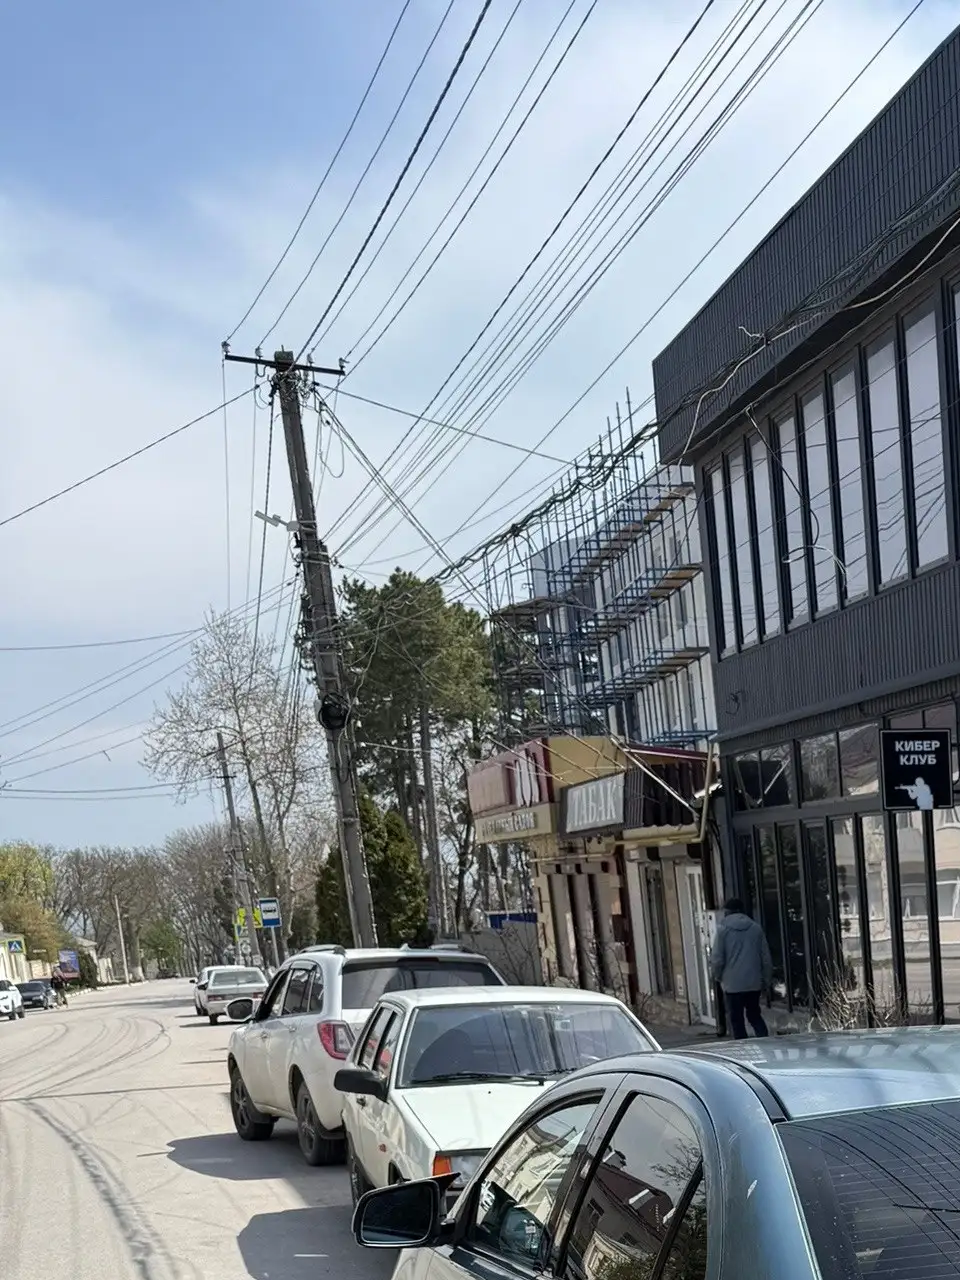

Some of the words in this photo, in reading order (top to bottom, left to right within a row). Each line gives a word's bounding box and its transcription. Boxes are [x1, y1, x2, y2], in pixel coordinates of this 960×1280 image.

[895, 739, 941, 752] КИБЕР
[899, 753, 937, 766] КЛУБ
[572, 783, 617, 827] ТАБАК
